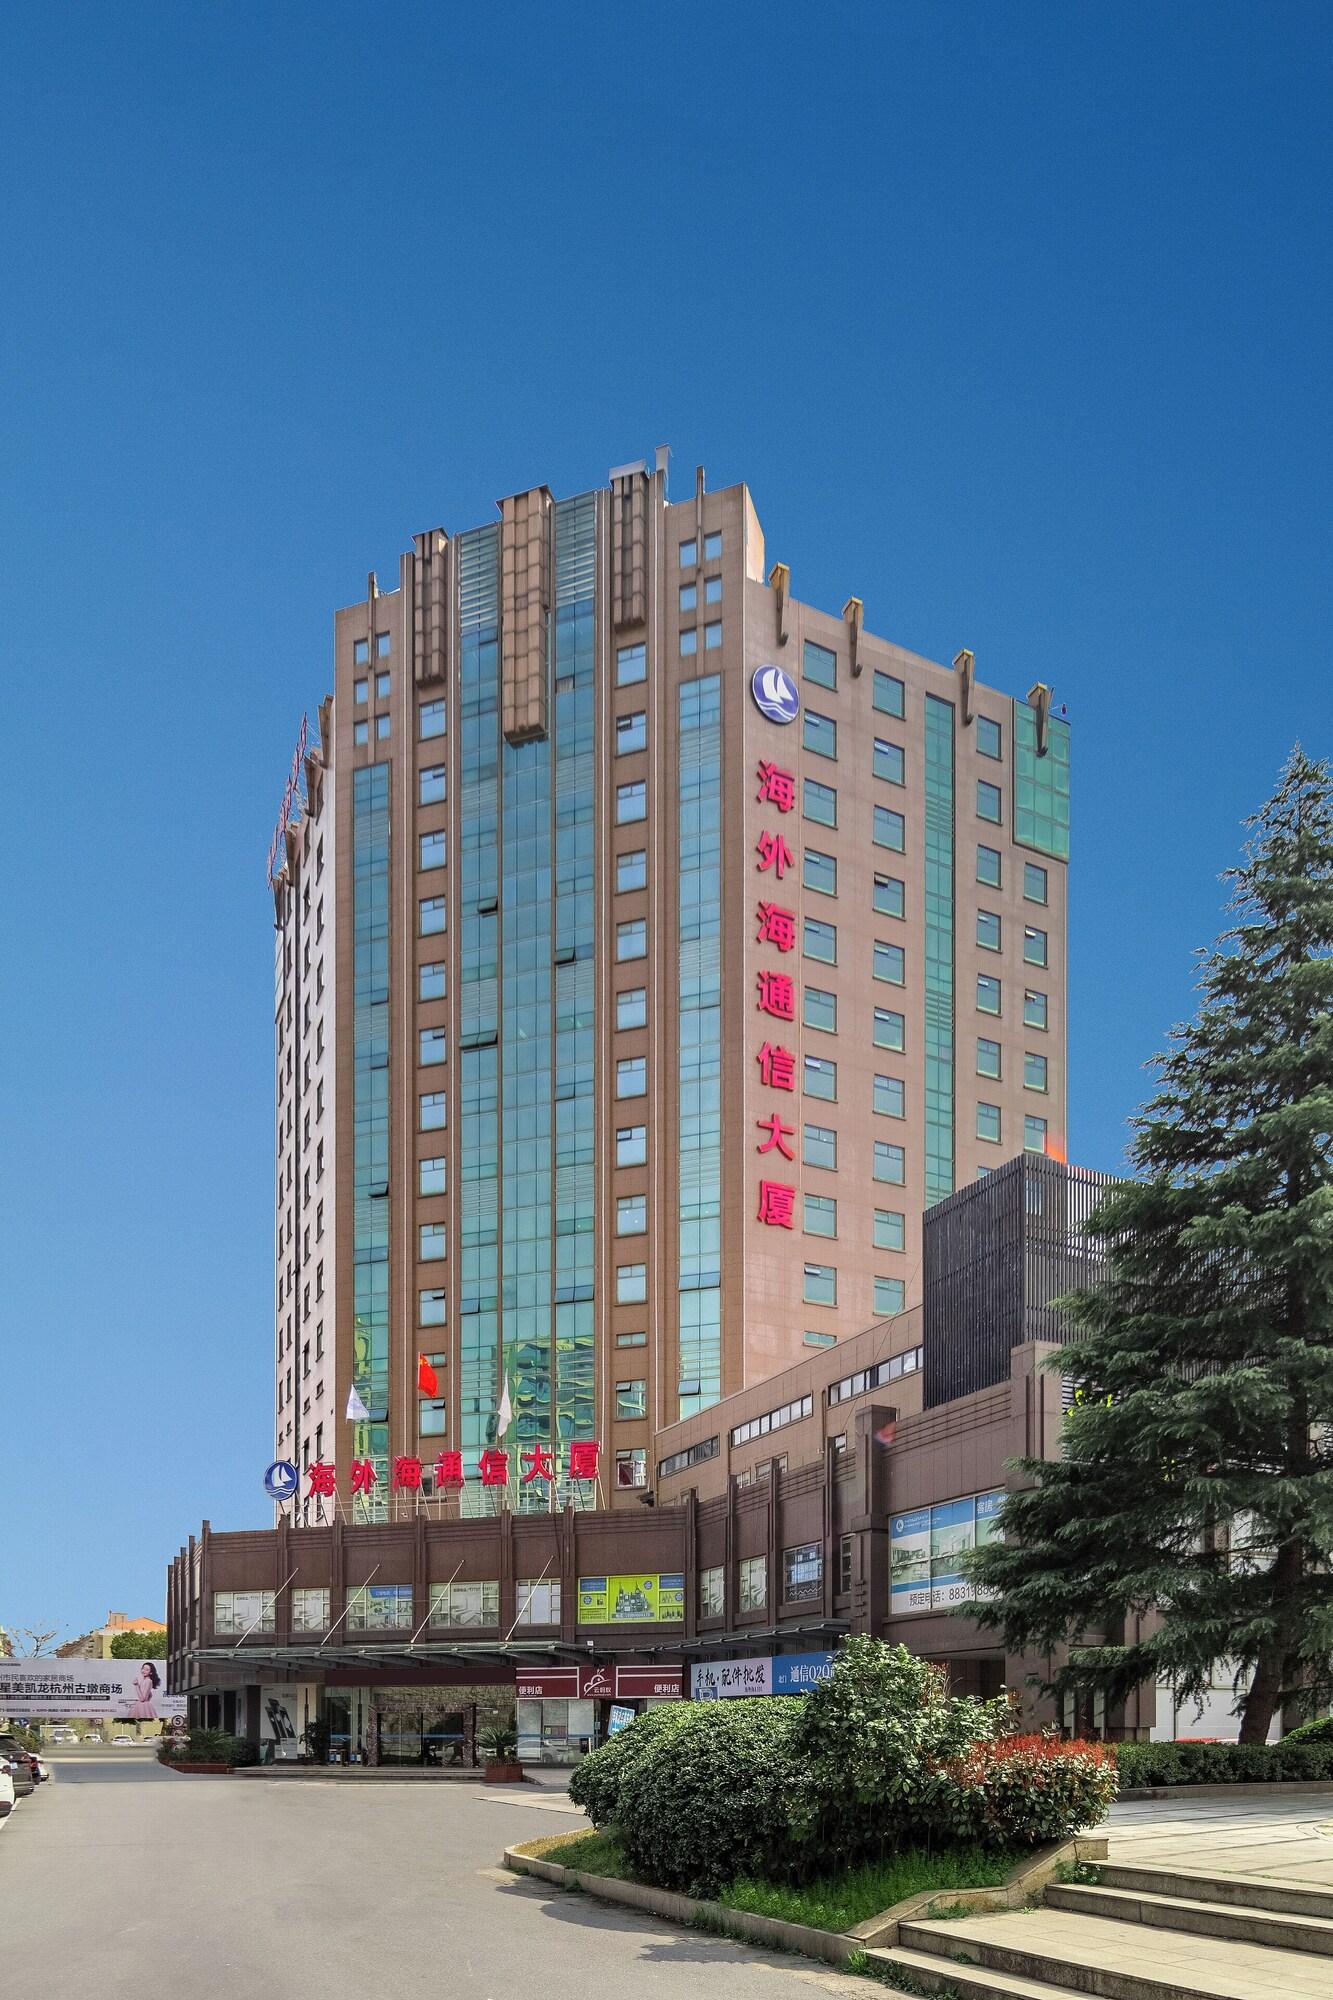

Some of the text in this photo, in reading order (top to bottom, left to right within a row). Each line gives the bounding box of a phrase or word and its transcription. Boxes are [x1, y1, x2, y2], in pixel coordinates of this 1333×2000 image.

[756, 758, 797, 1228] 海外海通信大厦
[308, 1441, 600, 1498] 海外海通信大厦
[0, 1682, 123, 1694] 星美凯龙杭州古墩商场
[519, 1685, 543, 1695] 便利店
[654, 1684, 680, 1693] 便利店
[175, 1717, 181, 1725] 5
